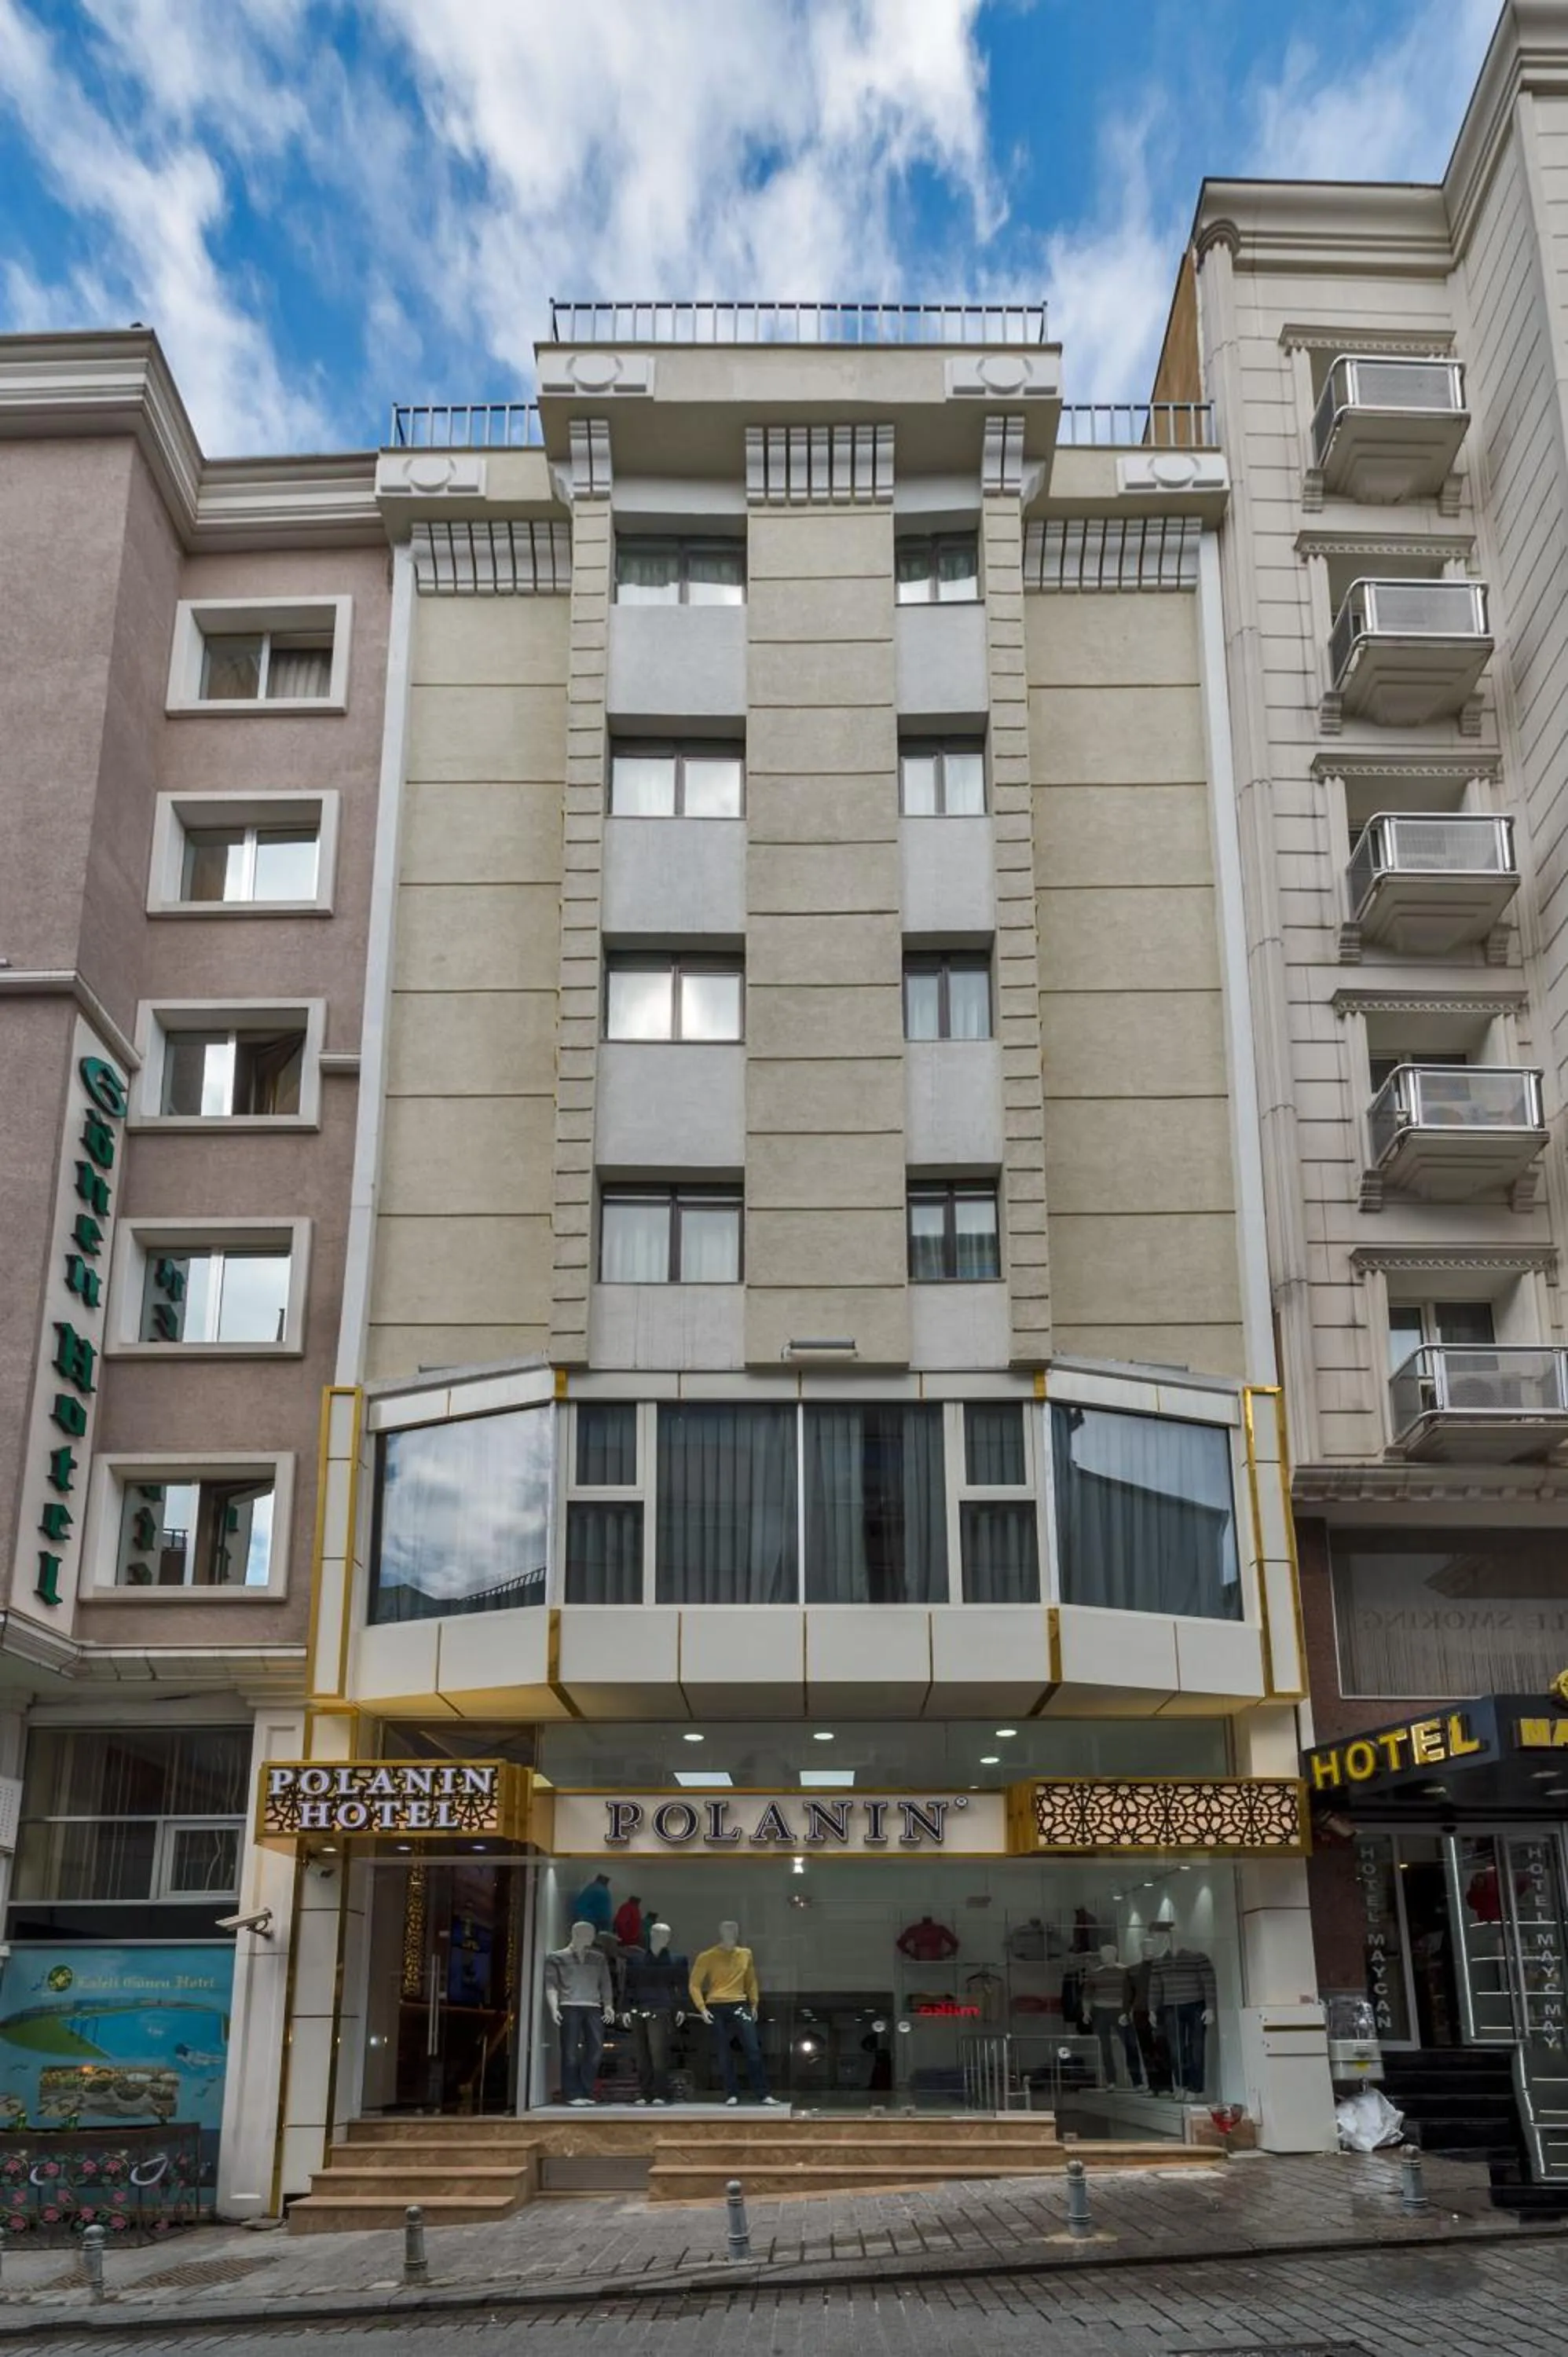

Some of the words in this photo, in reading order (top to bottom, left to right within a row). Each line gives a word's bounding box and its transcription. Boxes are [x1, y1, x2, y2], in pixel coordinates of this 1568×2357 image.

[35, 1321, 97, 1606] Hotel
[269, 1768, 494, 1796] POLANIN
[1311, 1712, 1480, 1791] HOTEL
[299, 1801, 458, 1829] HOTEL
[1360, 1846, 1379, 1923] HOTEL
[1528, 1846, 1548, 1923] HOTEL
[1368, 1934, 1392, 2029] MAYCAN
